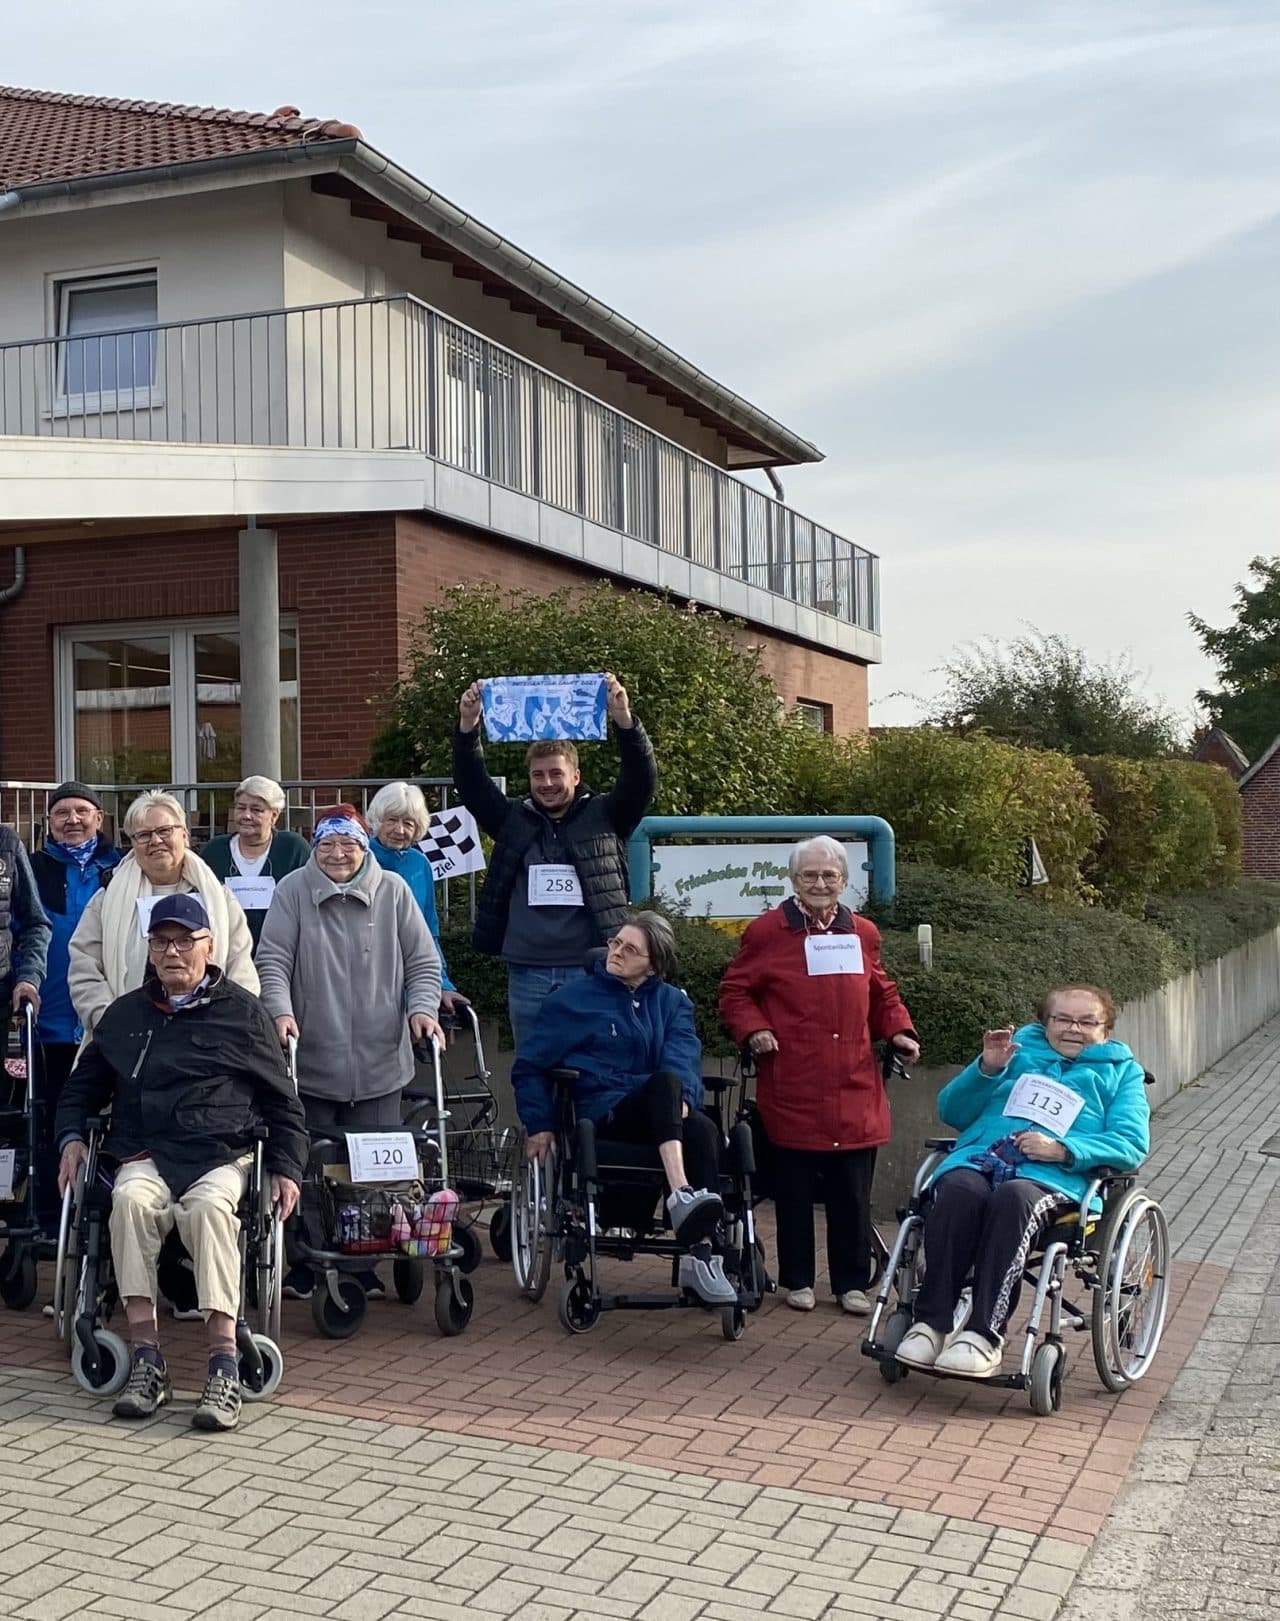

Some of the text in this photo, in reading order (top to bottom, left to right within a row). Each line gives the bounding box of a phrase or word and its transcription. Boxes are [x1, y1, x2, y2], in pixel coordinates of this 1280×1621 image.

[433, 857, 456, 878] Ziel
[751, 860, 791, 881] Pfleg
[545, 878, 574, 892] 258
[1027, 1091, 1063, 1116] 113
[371, 1148, 403, 1165] 120
